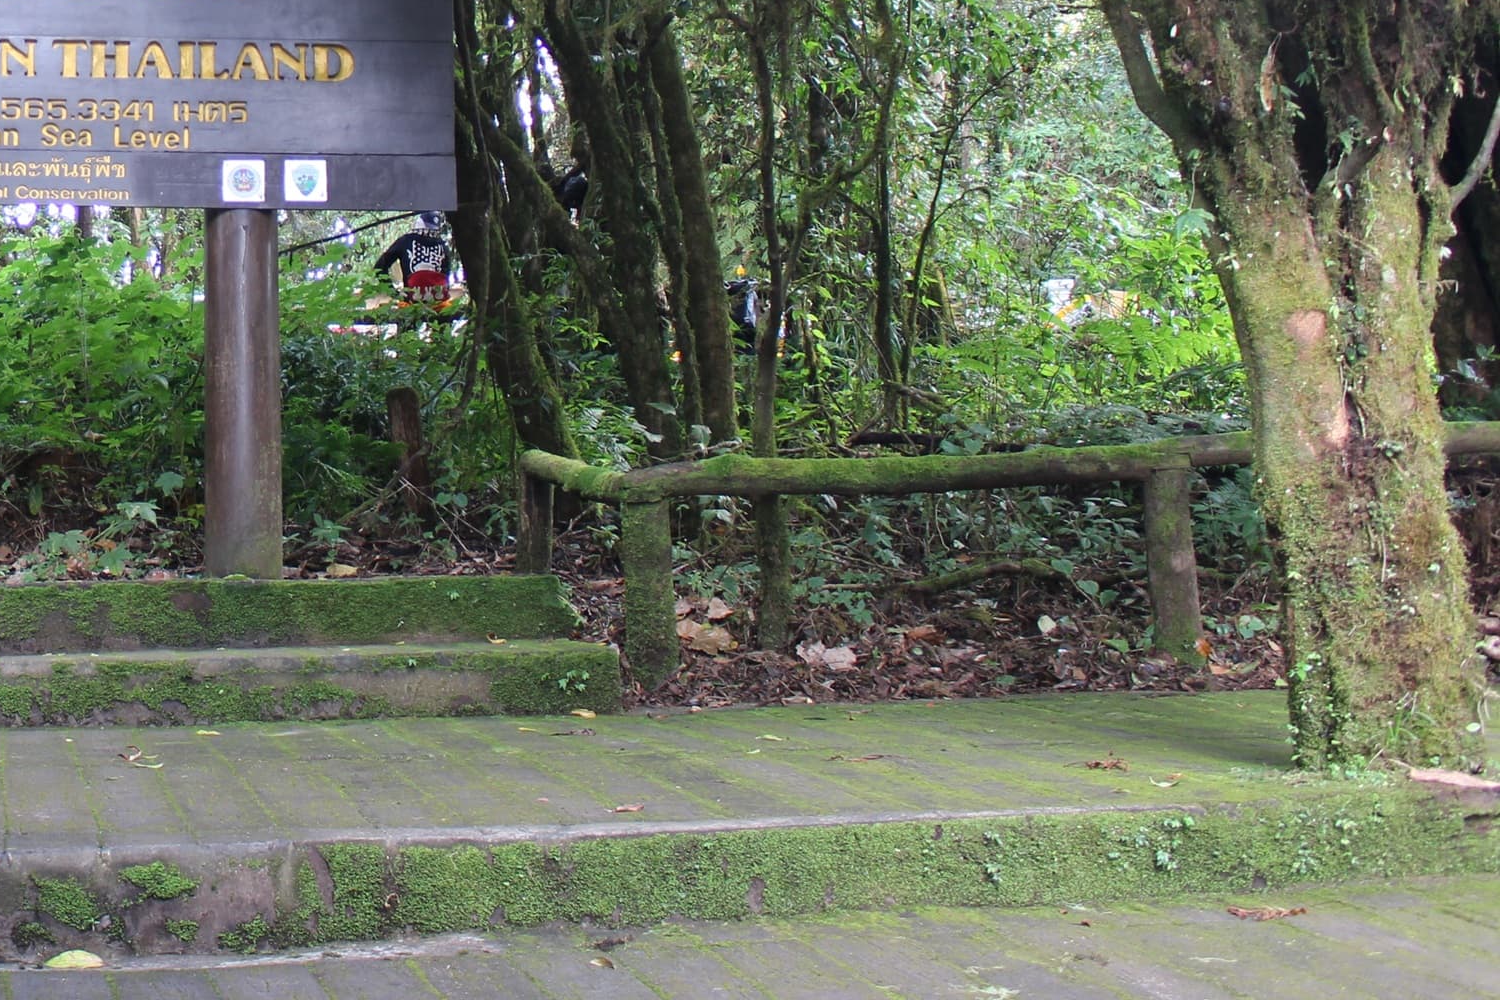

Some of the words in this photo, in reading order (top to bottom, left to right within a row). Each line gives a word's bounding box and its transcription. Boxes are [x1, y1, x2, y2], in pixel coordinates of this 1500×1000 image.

[52, 39, 356, 82] THAILAND
[173, 100, 249, 124] เมตร
[40, 123, 93, 147] Sea
[113, 126, 191, 149] Level
[15, 186, 130, 200] Conservation
